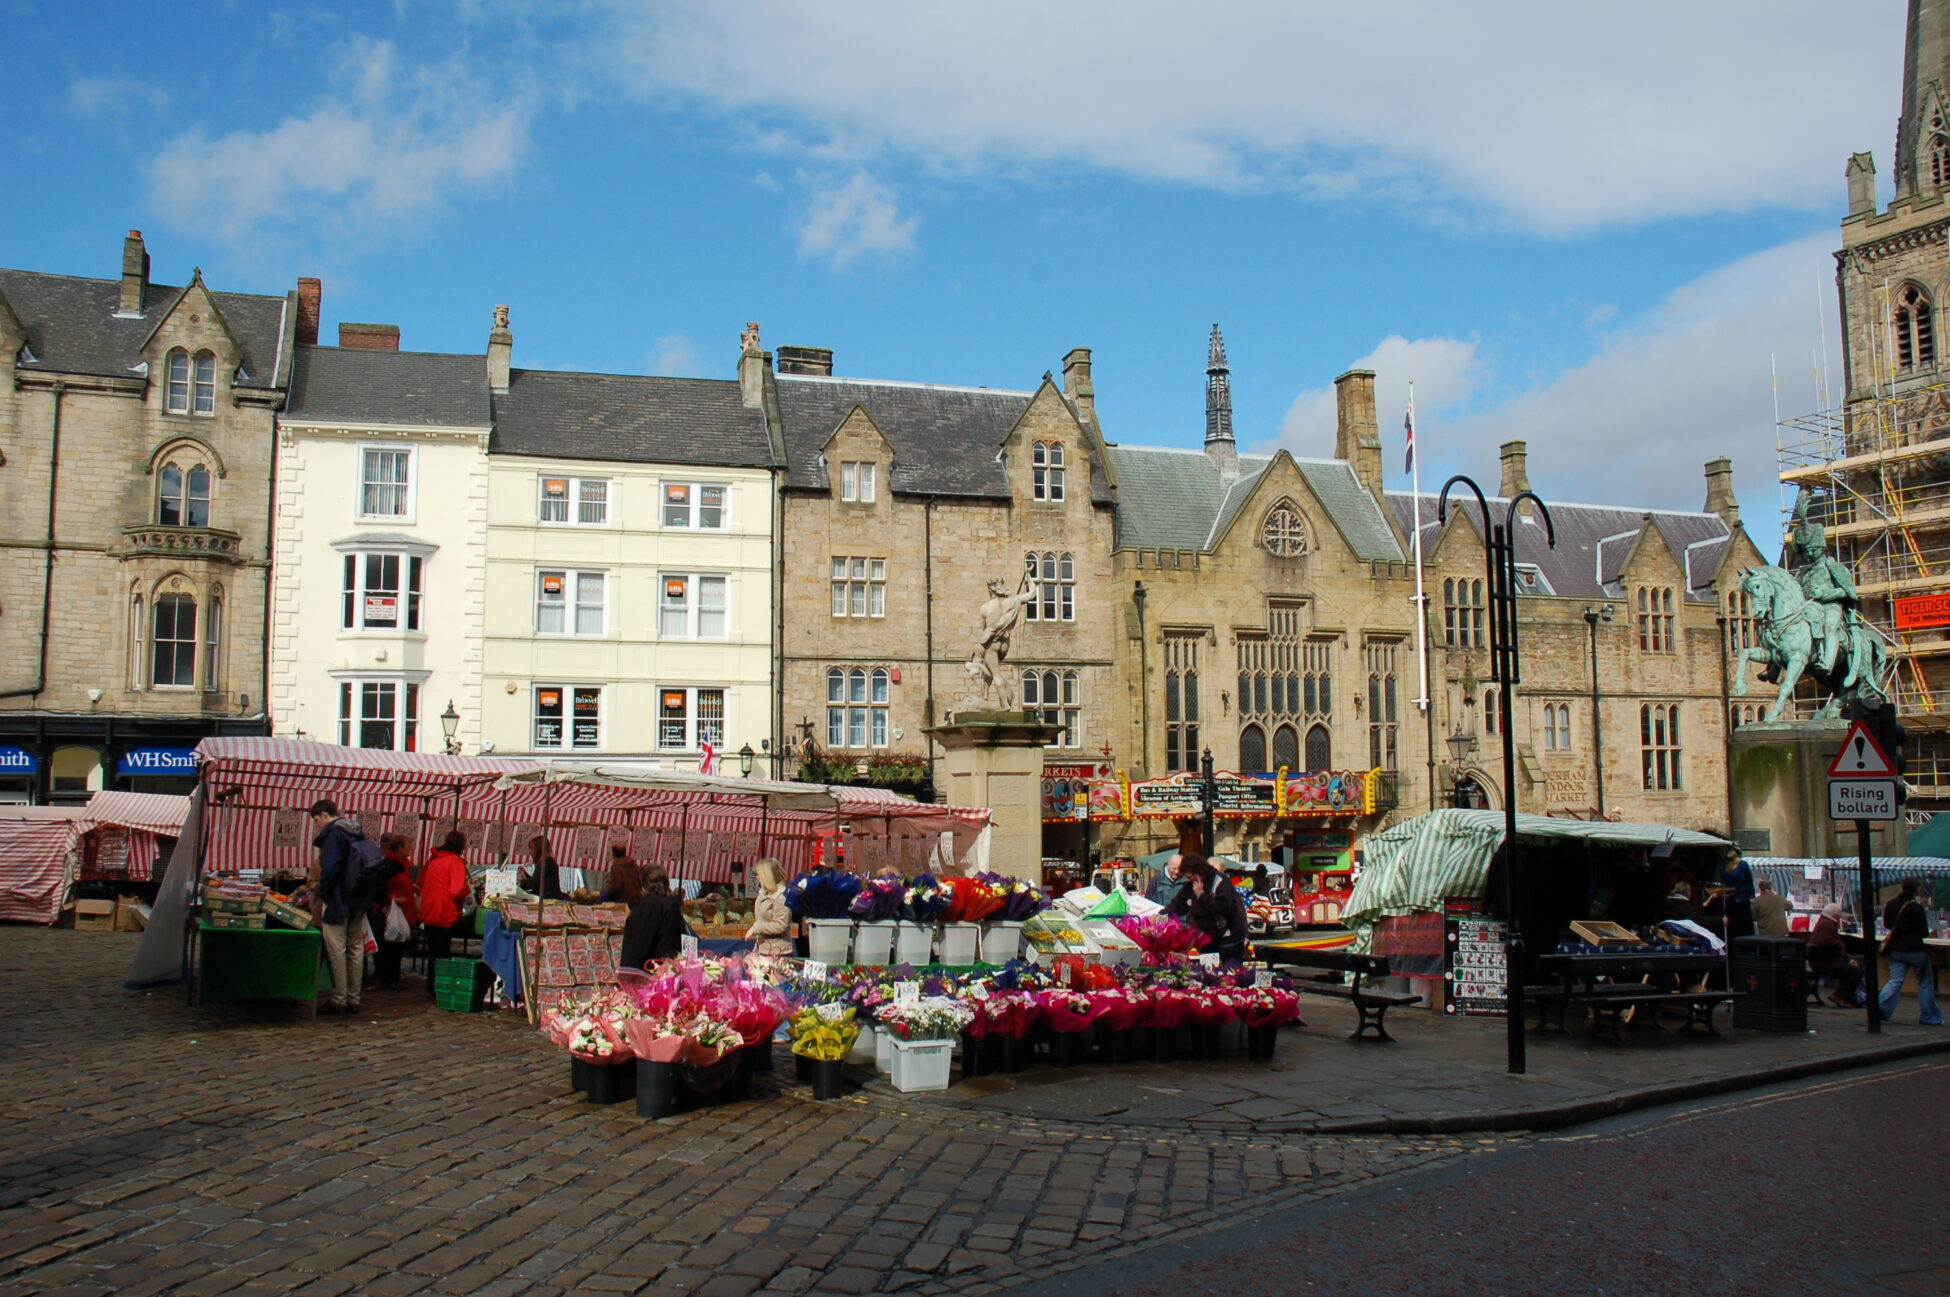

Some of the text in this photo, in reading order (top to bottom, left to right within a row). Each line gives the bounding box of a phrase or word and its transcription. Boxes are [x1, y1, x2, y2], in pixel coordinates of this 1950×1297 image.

[1901, 601, 1934, 615] TIGER
[1041, 767, 1081, 777] RKETS
[1840, 787, 1884, 801] Rising
[1837, 802, 1889, 813] bollard
